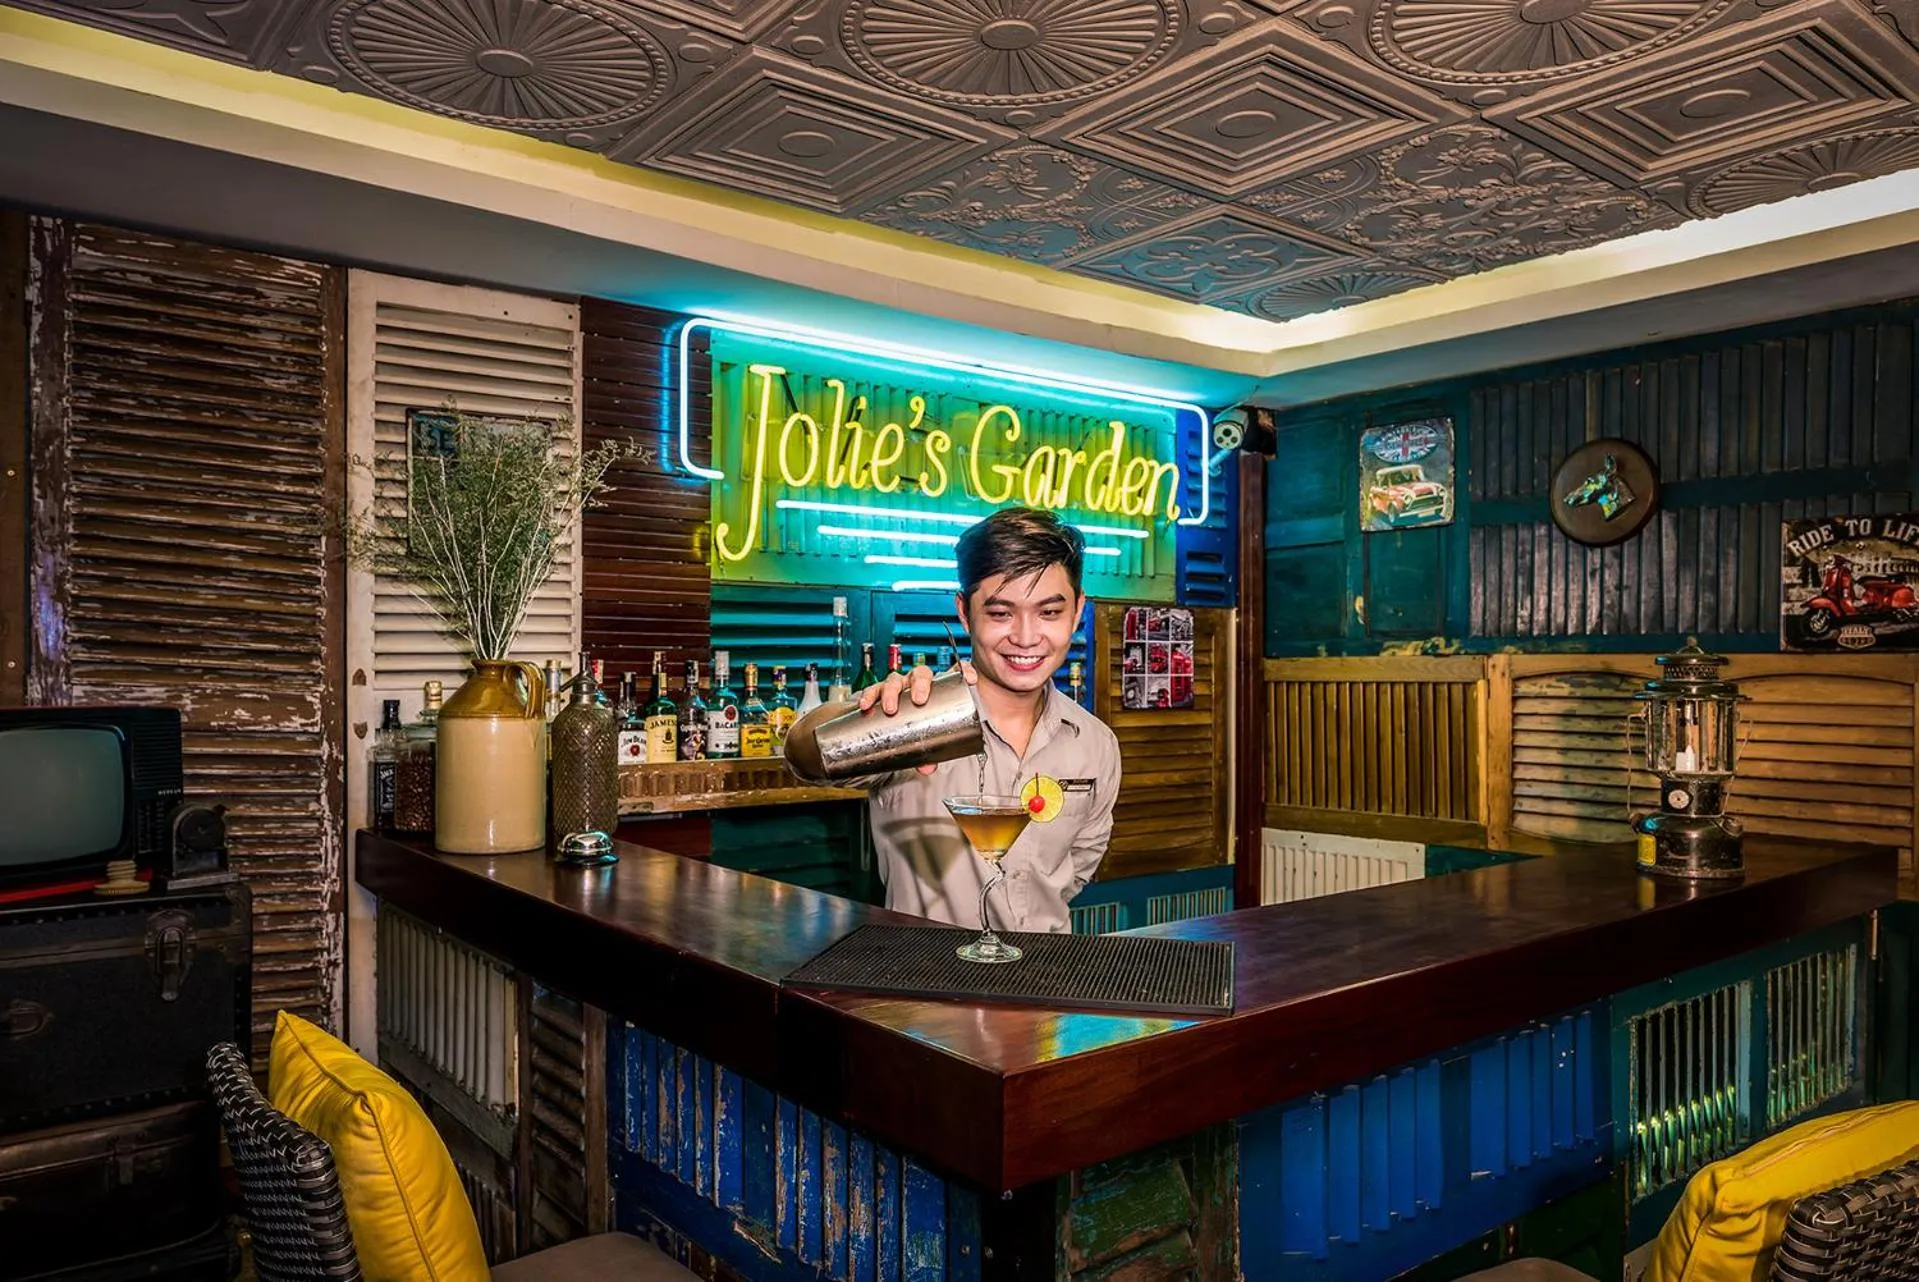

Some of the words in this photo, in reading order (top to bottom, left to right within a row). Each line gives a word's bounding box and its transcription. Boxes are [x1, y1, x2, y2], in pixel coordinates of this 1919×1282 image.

[715, 364, 952, 561] Jolie's
[971, 405, 1181, 521] Garden
[1788, 524, 1834, 557] RIDE
[1844, 518, 1871, 537] TO
[1882, 519, 1919, 545] LIF
